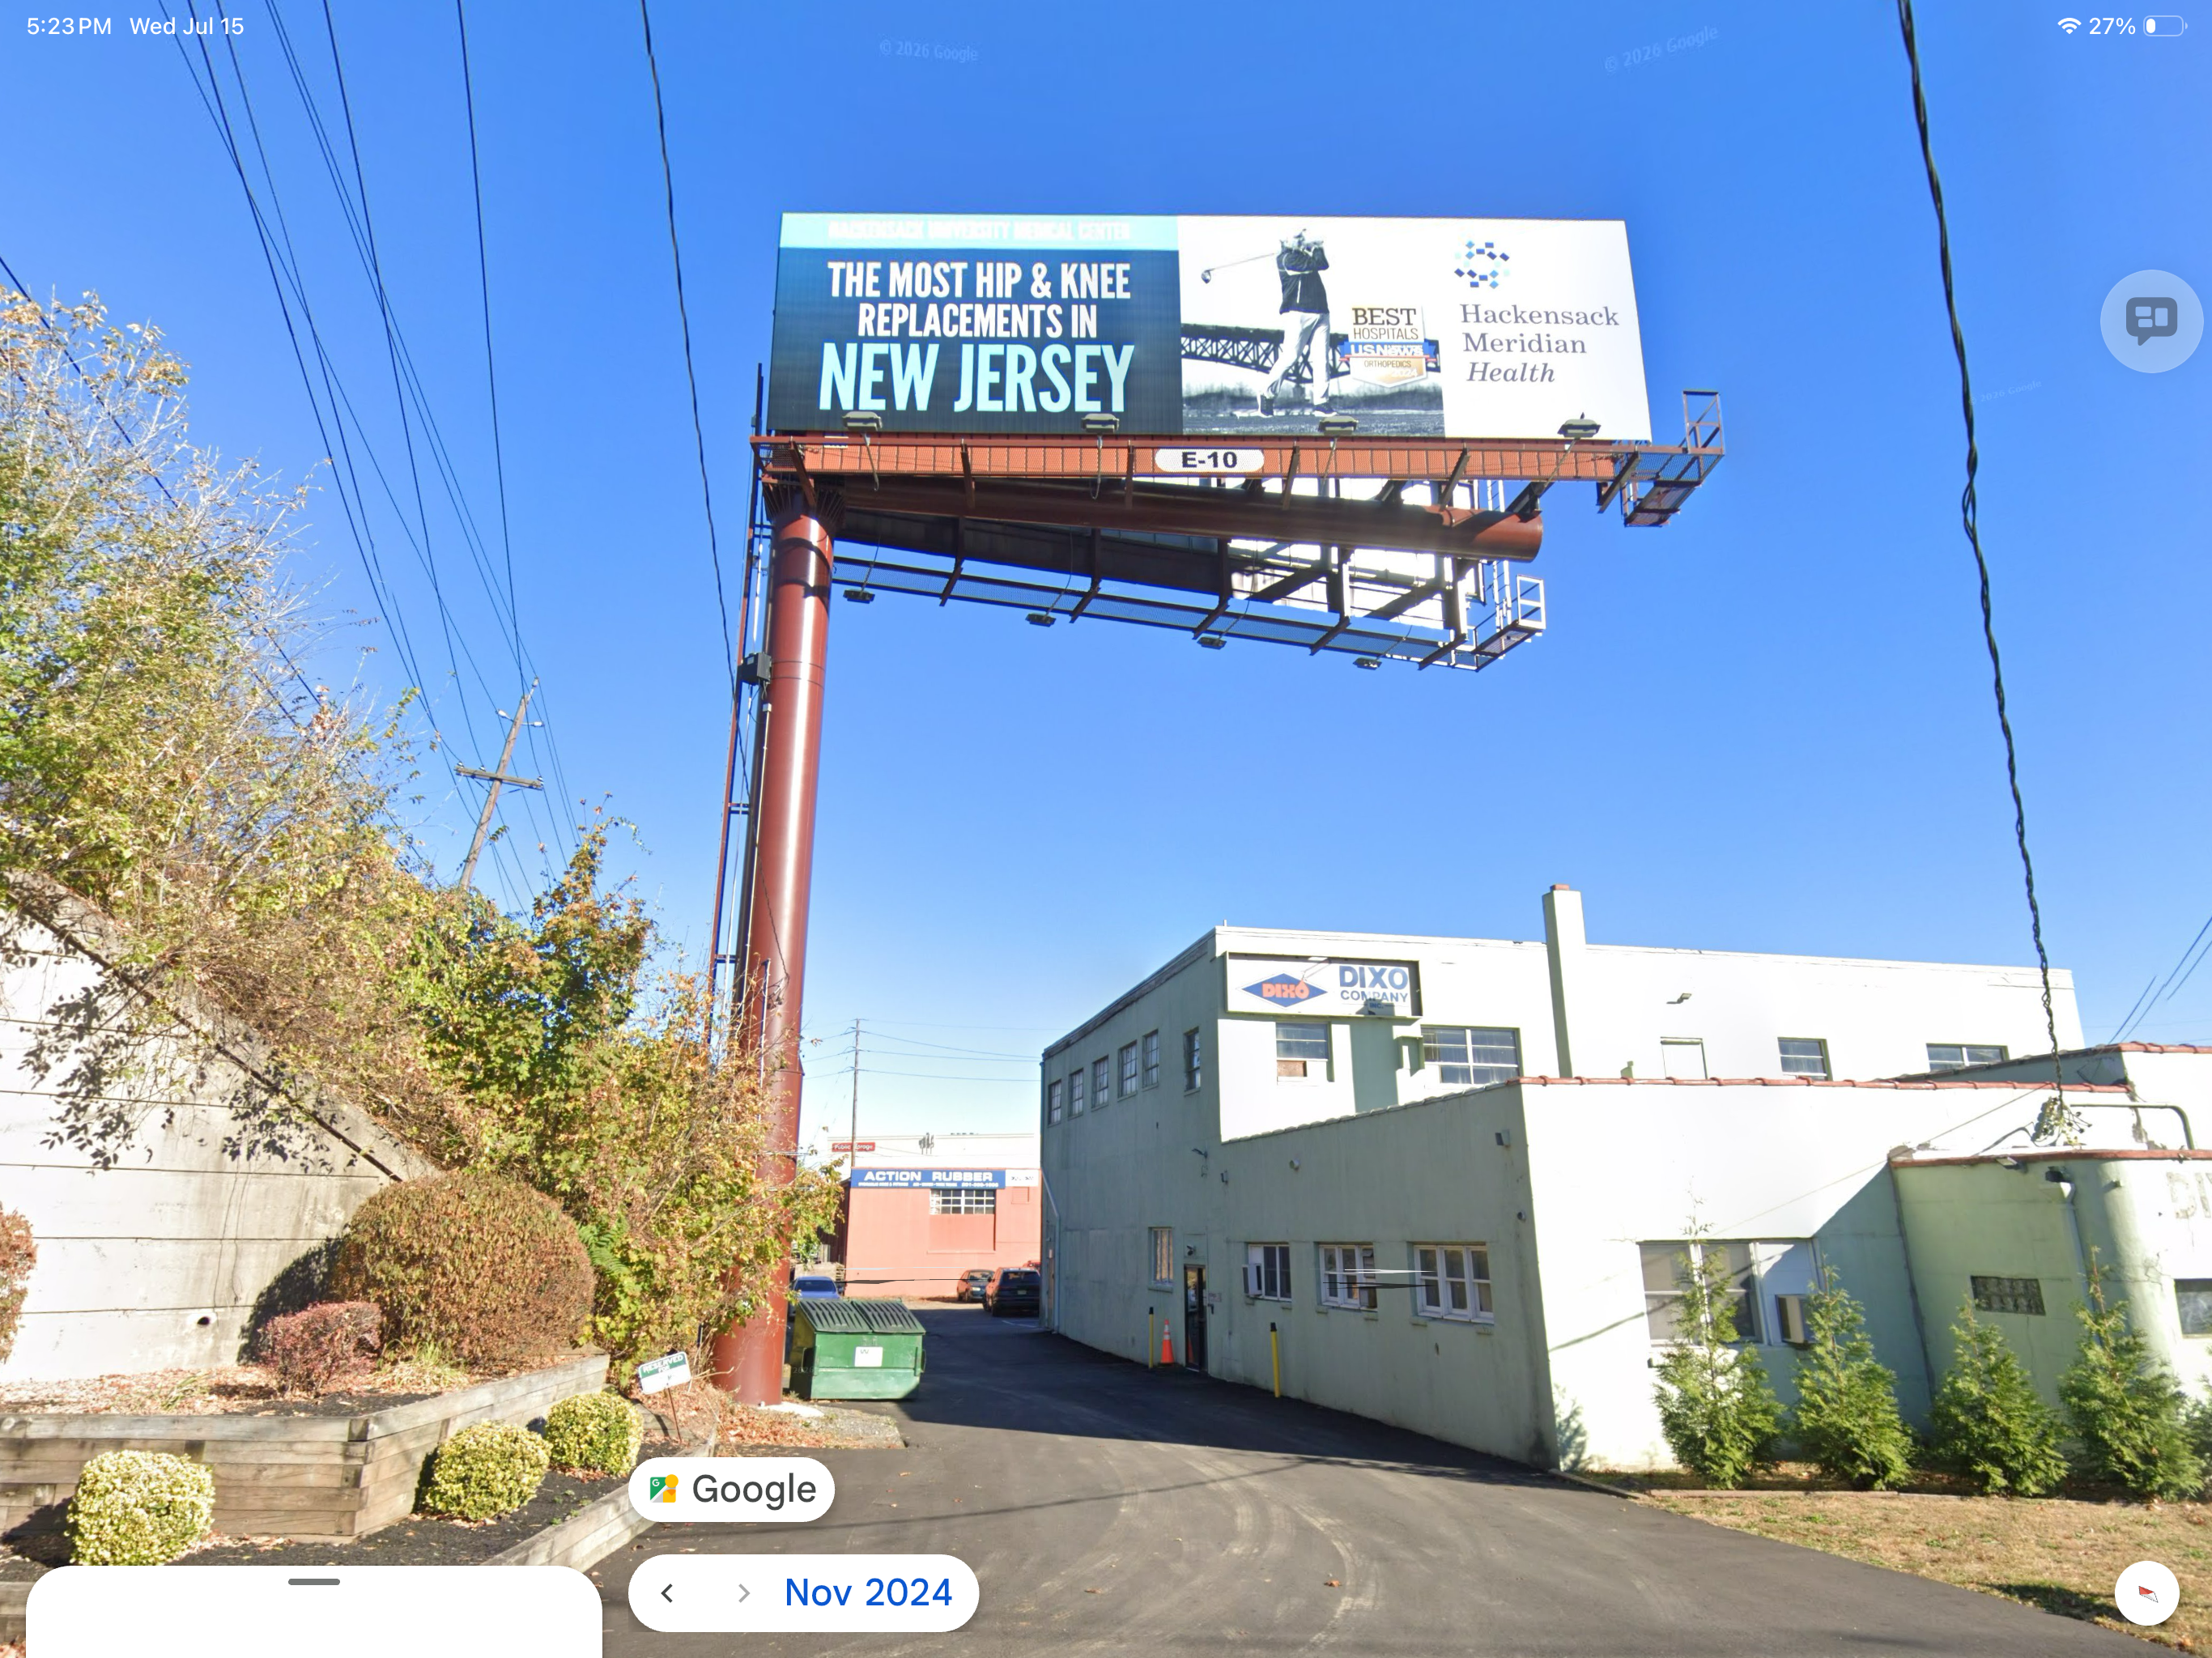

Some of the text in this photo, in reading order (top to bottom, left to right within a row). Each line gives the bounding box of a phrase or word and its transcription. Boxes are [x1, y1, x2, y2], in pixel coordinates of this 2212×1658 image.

[827, 261, 1132, 299] THE MOST HIP & KNEE
[858, 304, 1098, 338] REPLACEMENTS IN
[1351, 308, 1417, 326] BEST
[1460, 304, 1620, 327] Hackensack
[1353, 328, 1419, 340] HOSPITALS
[1462, 332, 1587, 354] Meridian
[1363, 360, 1412, 368] ORTHOPEDICS
[1466, 360, 1556, 383] Health
[819, 342, 1135, 413] NEW JERSEY
[1181, 451, 1238, 470] E-10
[1339, 966, 1409, 990] DIXO
[1262, 981, 1310, 1000] DIXO
[1340, 989, 1409, 1003] COMPANY
[855, 1143, 874, 1152] torage
[864, 1171, 993, 1182] ACTION RUBBER
[643, 1354, 684, 1374] RESERVED
[657, 1365, 670, 1373] FOR
